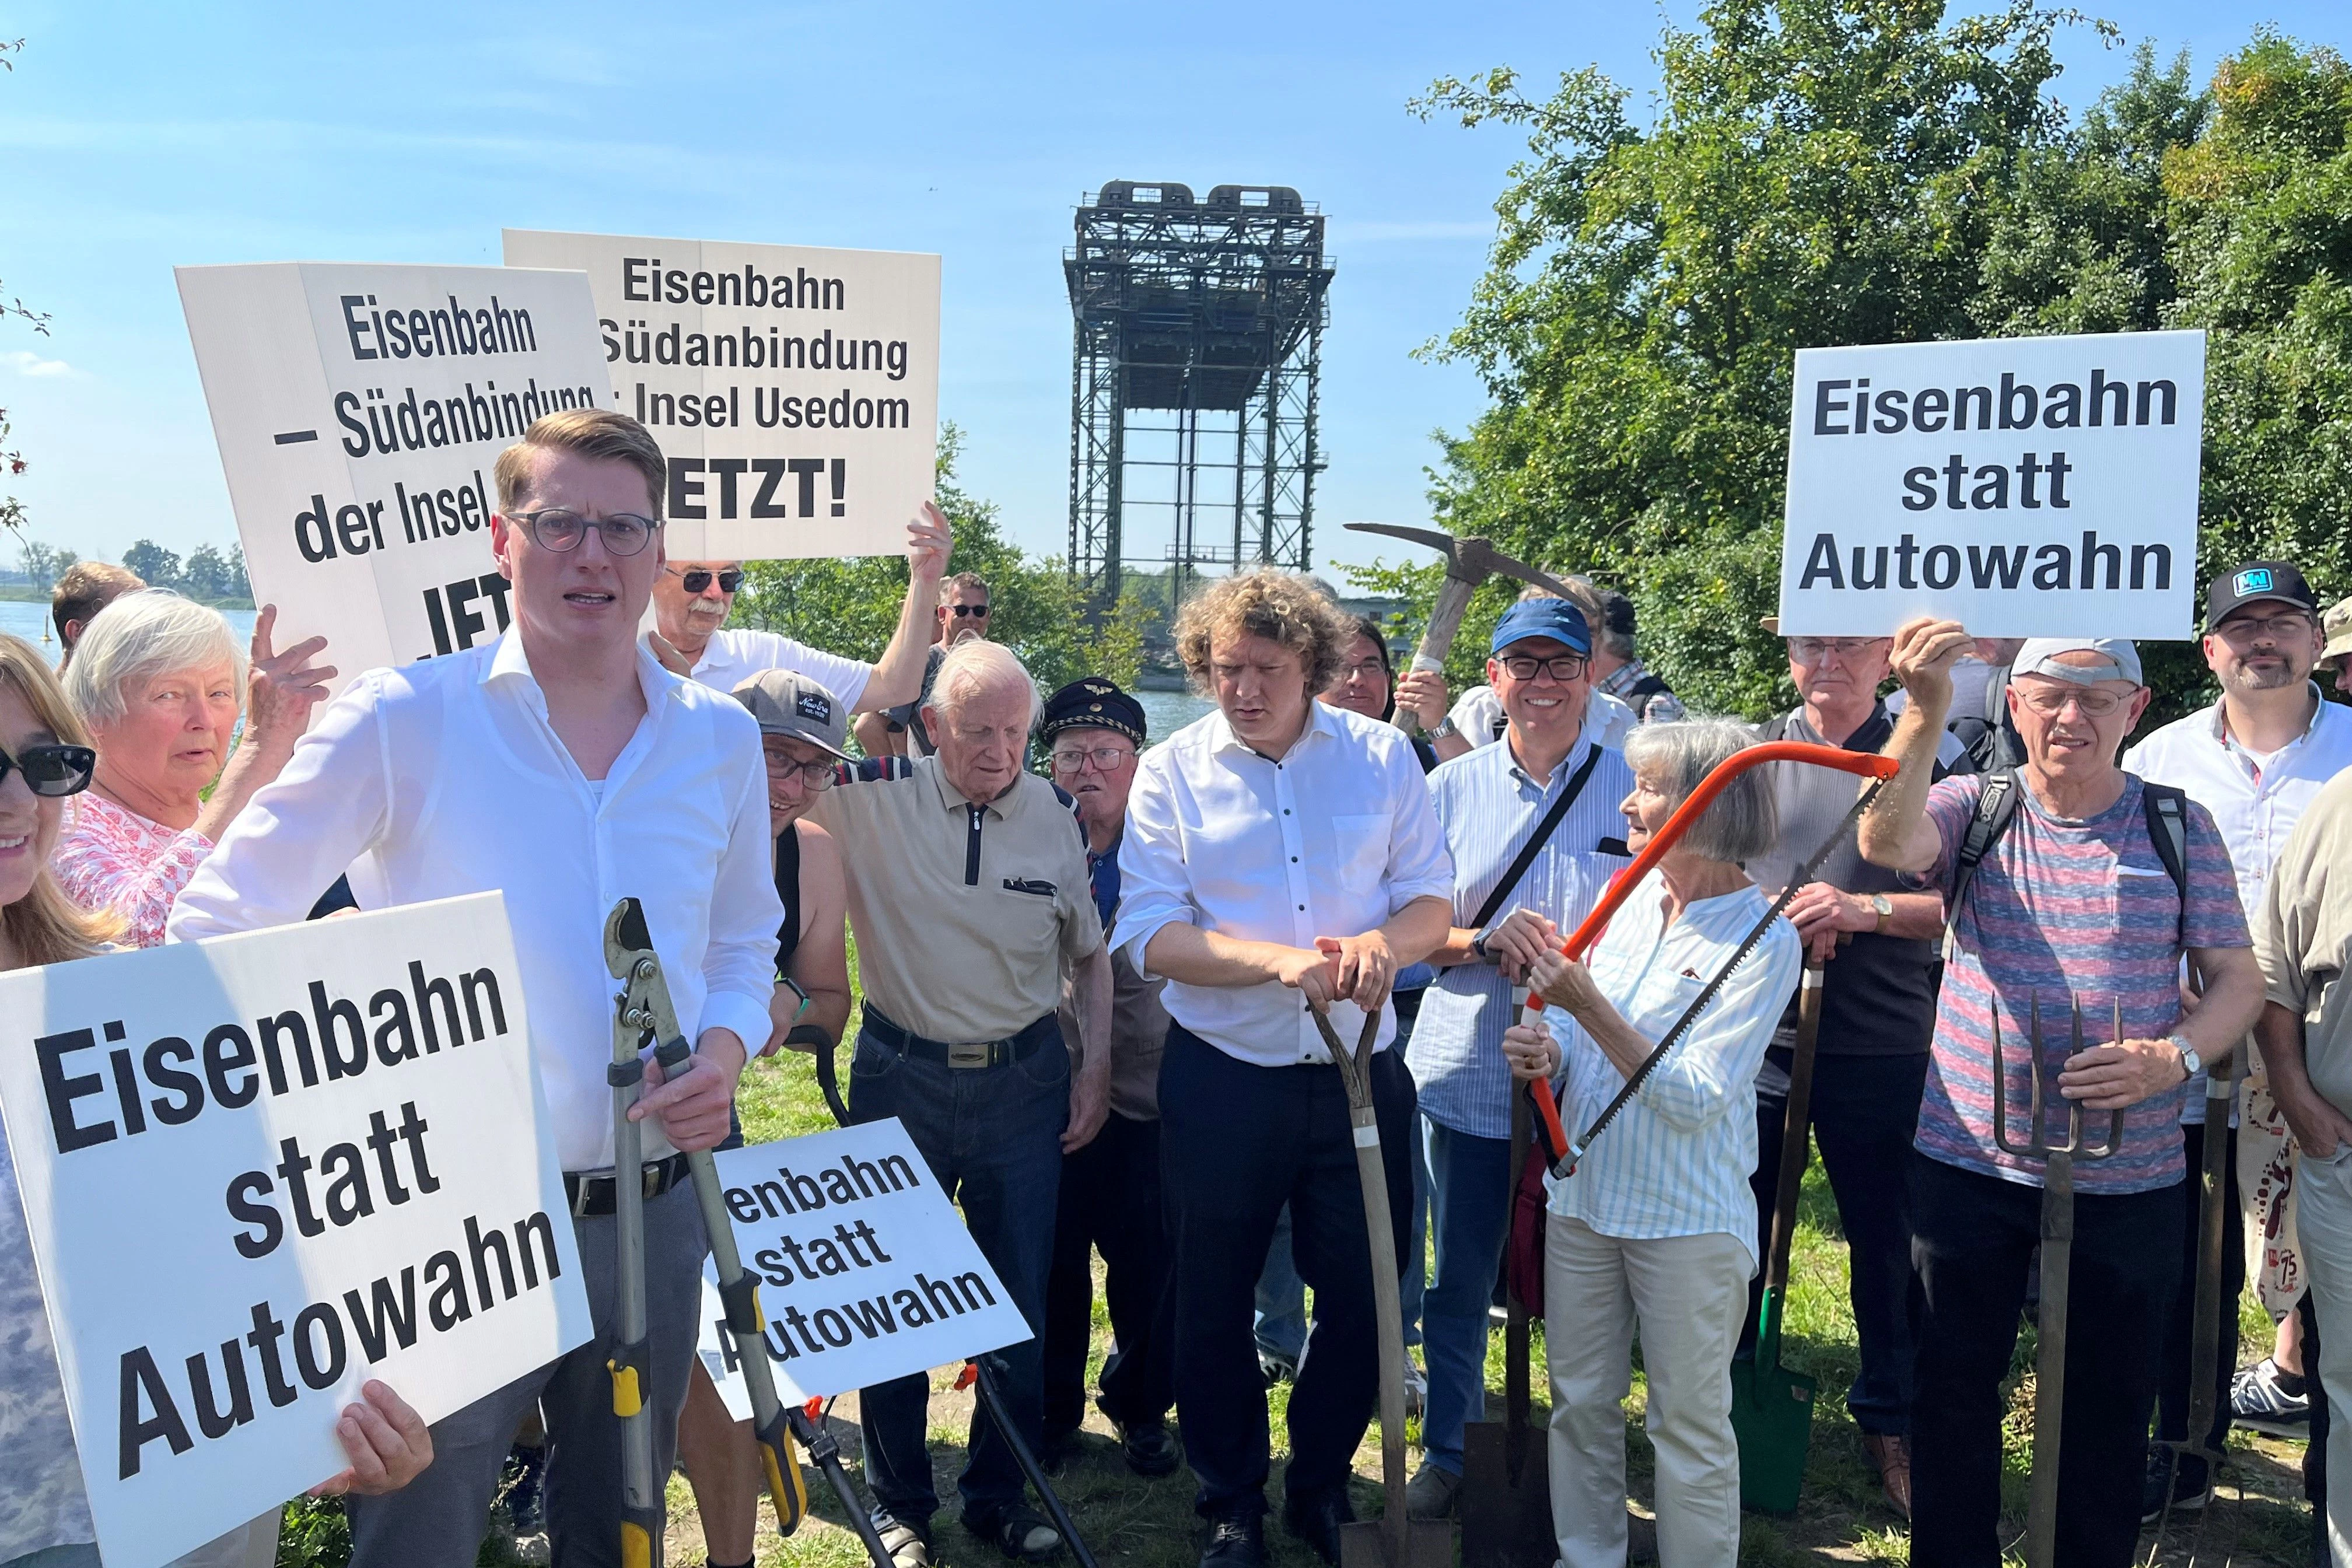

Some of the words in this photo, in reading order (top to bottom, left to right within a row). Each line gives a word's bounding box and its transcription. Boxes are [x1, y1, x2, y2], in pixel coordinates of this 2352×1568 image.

[623, 258, 844, 310] Eisenbahn
[340, 295, 537, 360] Eisenbahn
[599, 318, 908, 381] Südanbindung
[636, 383, 738, 428] Insel
[755, 387, 909, 429] Usedom
[1814, 369, 2176, 435] Eisenbahn
[667, 457, 846, 520] ETZT!
[1902, 452, 2073, 511] statt
[295, 494, 385, 563] der
[394, 470, 491, 544] Insel
[1798, 531, 2172, 590] Autowahn
[34, 960, 508, 1154] Eisenbahn
[225, 1100, 442, 1259] statt
[723, 1155, 921, 1223] enbahn
[754, 1220, 892, 1287] statt
[2281, 1254, 2297, 1285] 75
[119, 1211, 562, 1482] Autowahn
